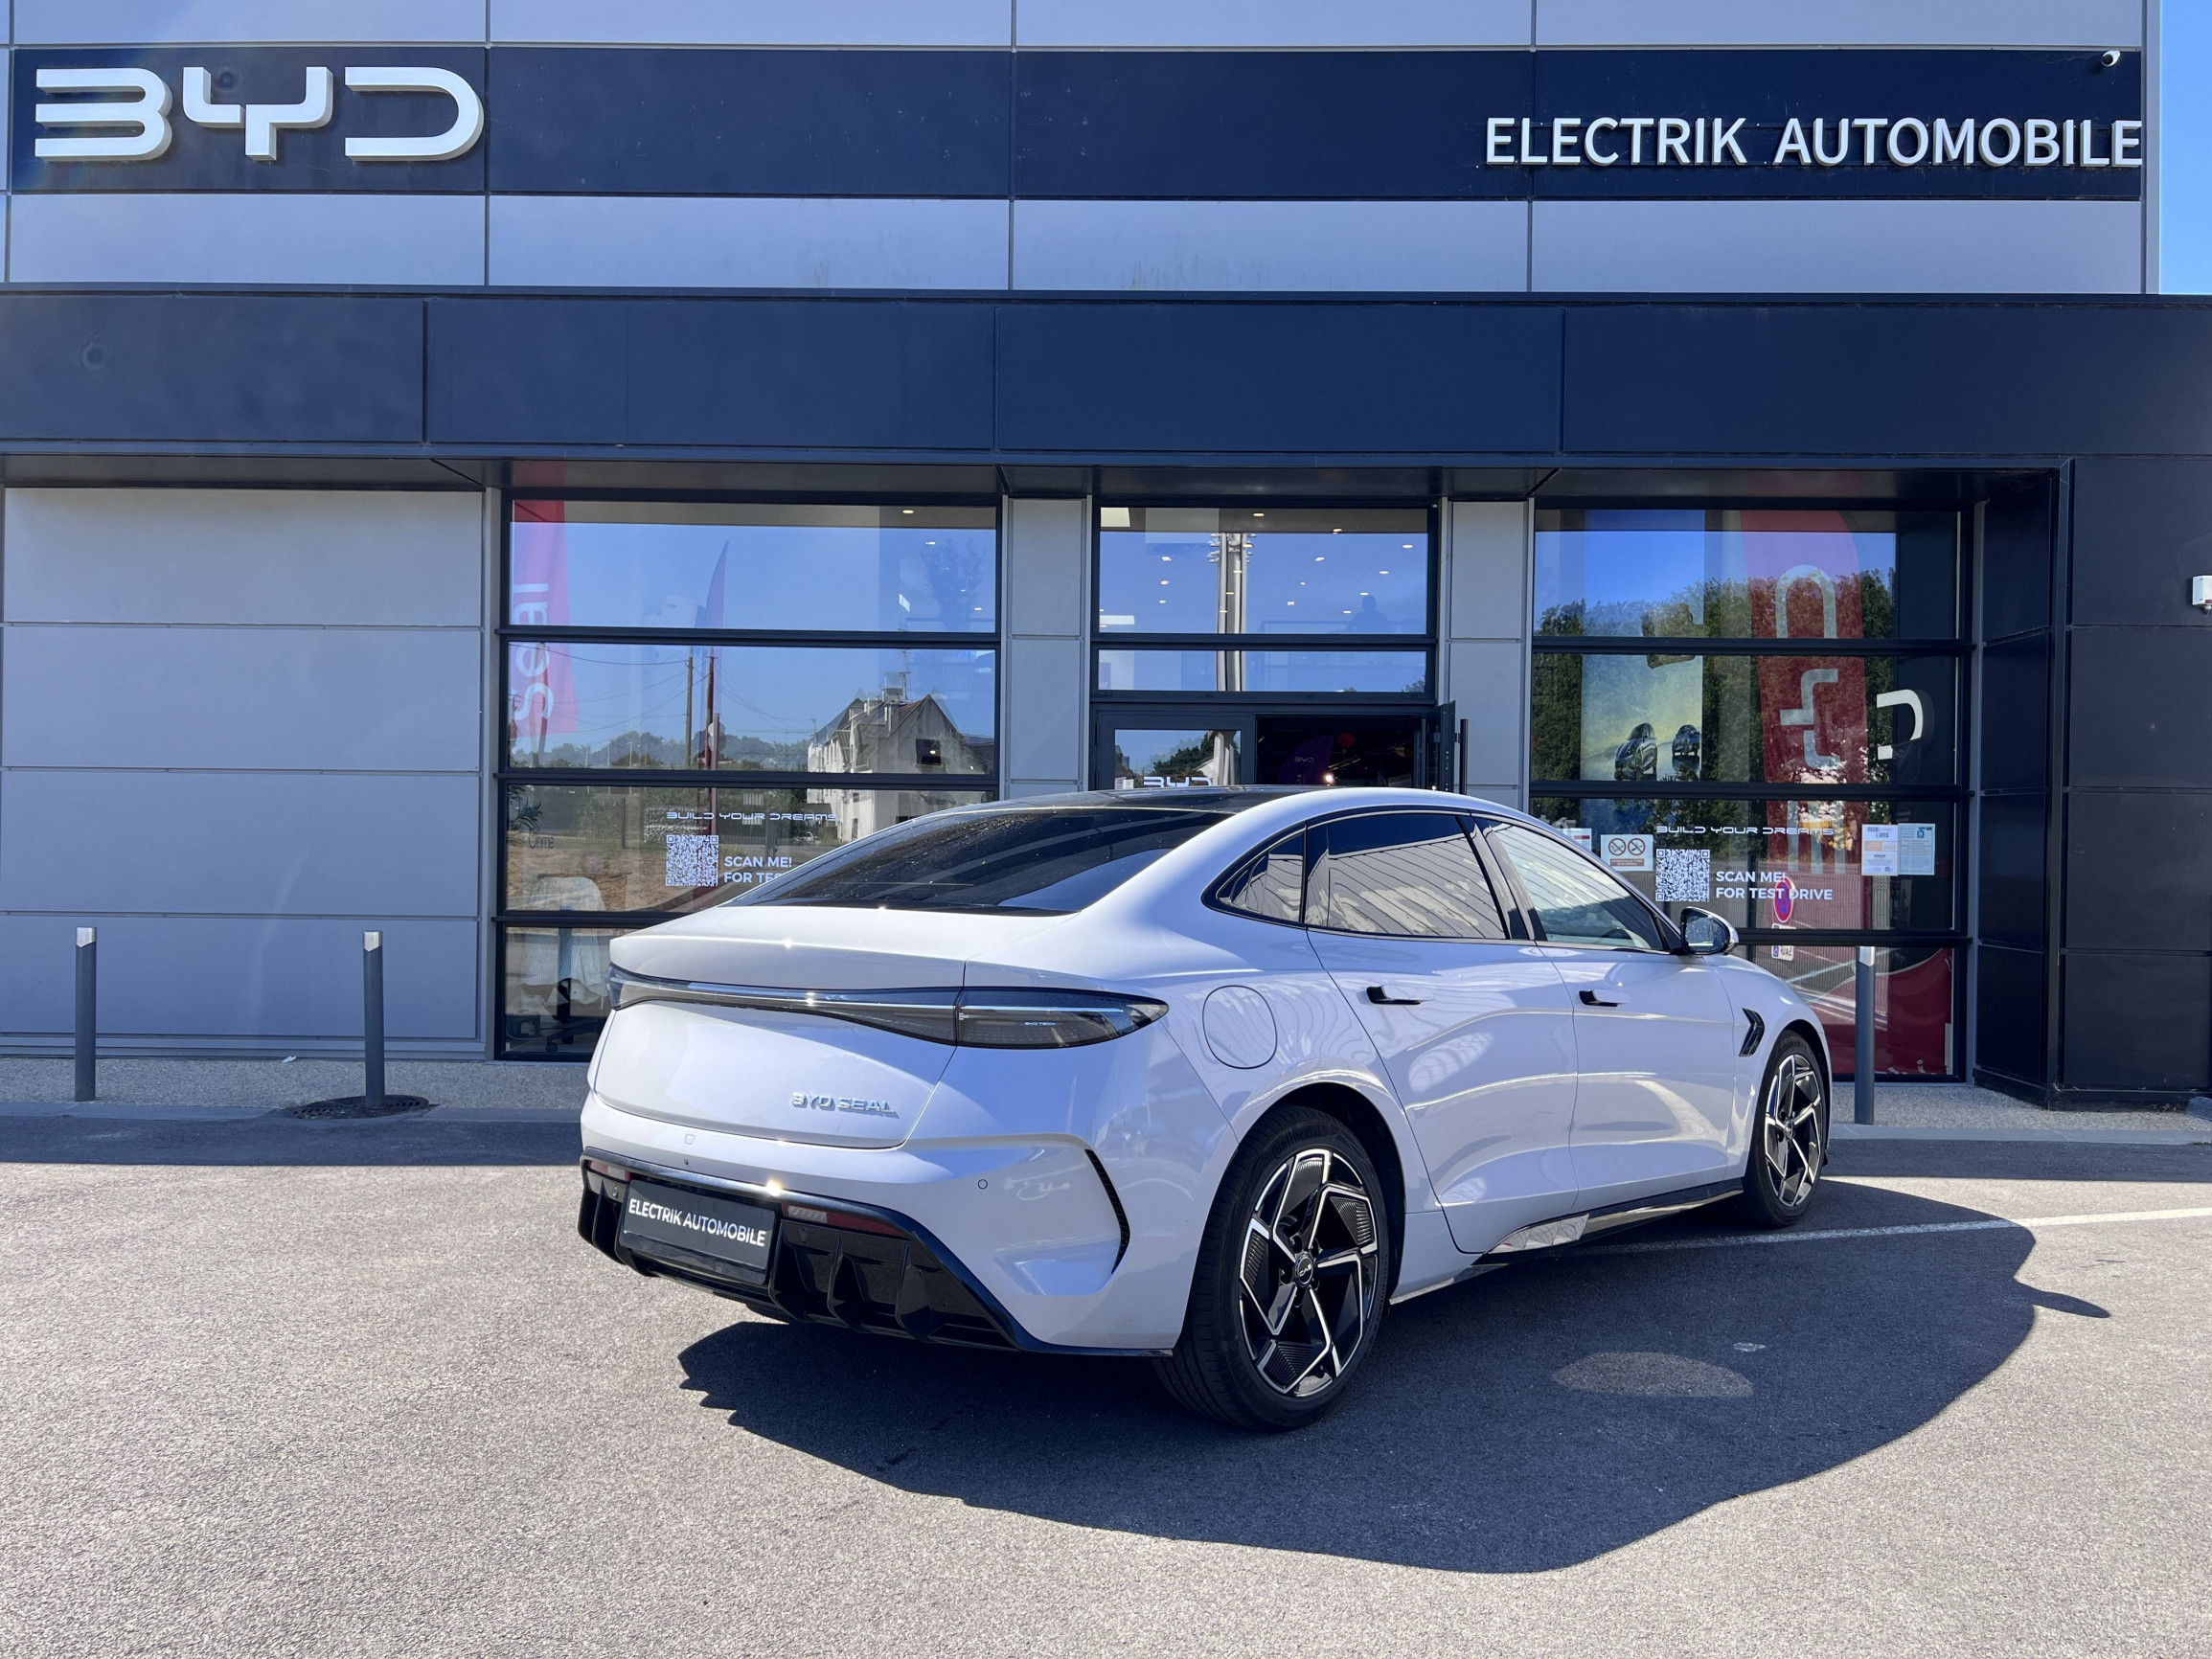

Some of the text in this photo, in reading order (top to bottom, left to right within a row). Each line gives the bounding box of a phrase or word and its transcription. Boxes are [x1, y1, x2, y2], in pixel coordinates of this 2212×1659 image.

[34, 66, 484, 162] BYD
[1485, 117, 2143, 168] ELECTRIK AUTOMOBILE
[666, 811, 839, 822] BUILD YOUR DREAMS
[1656, 826, 1706, 834] BUILD
[1762, 827, 1835, 835] DREAMS
[723, 855, 792, 868] SCAN ME!
[723, 872, 783, 883] FOR TE
[1715, 871, 1787, 883] SCAN ME!
[1716, 887, 1834, 900] FOR TEST DRIVE
[791, 1091, 897, 1114] BYD SEAL
[628, 1198, 766, 1247] ELECTRIK AUTOMOBILE
